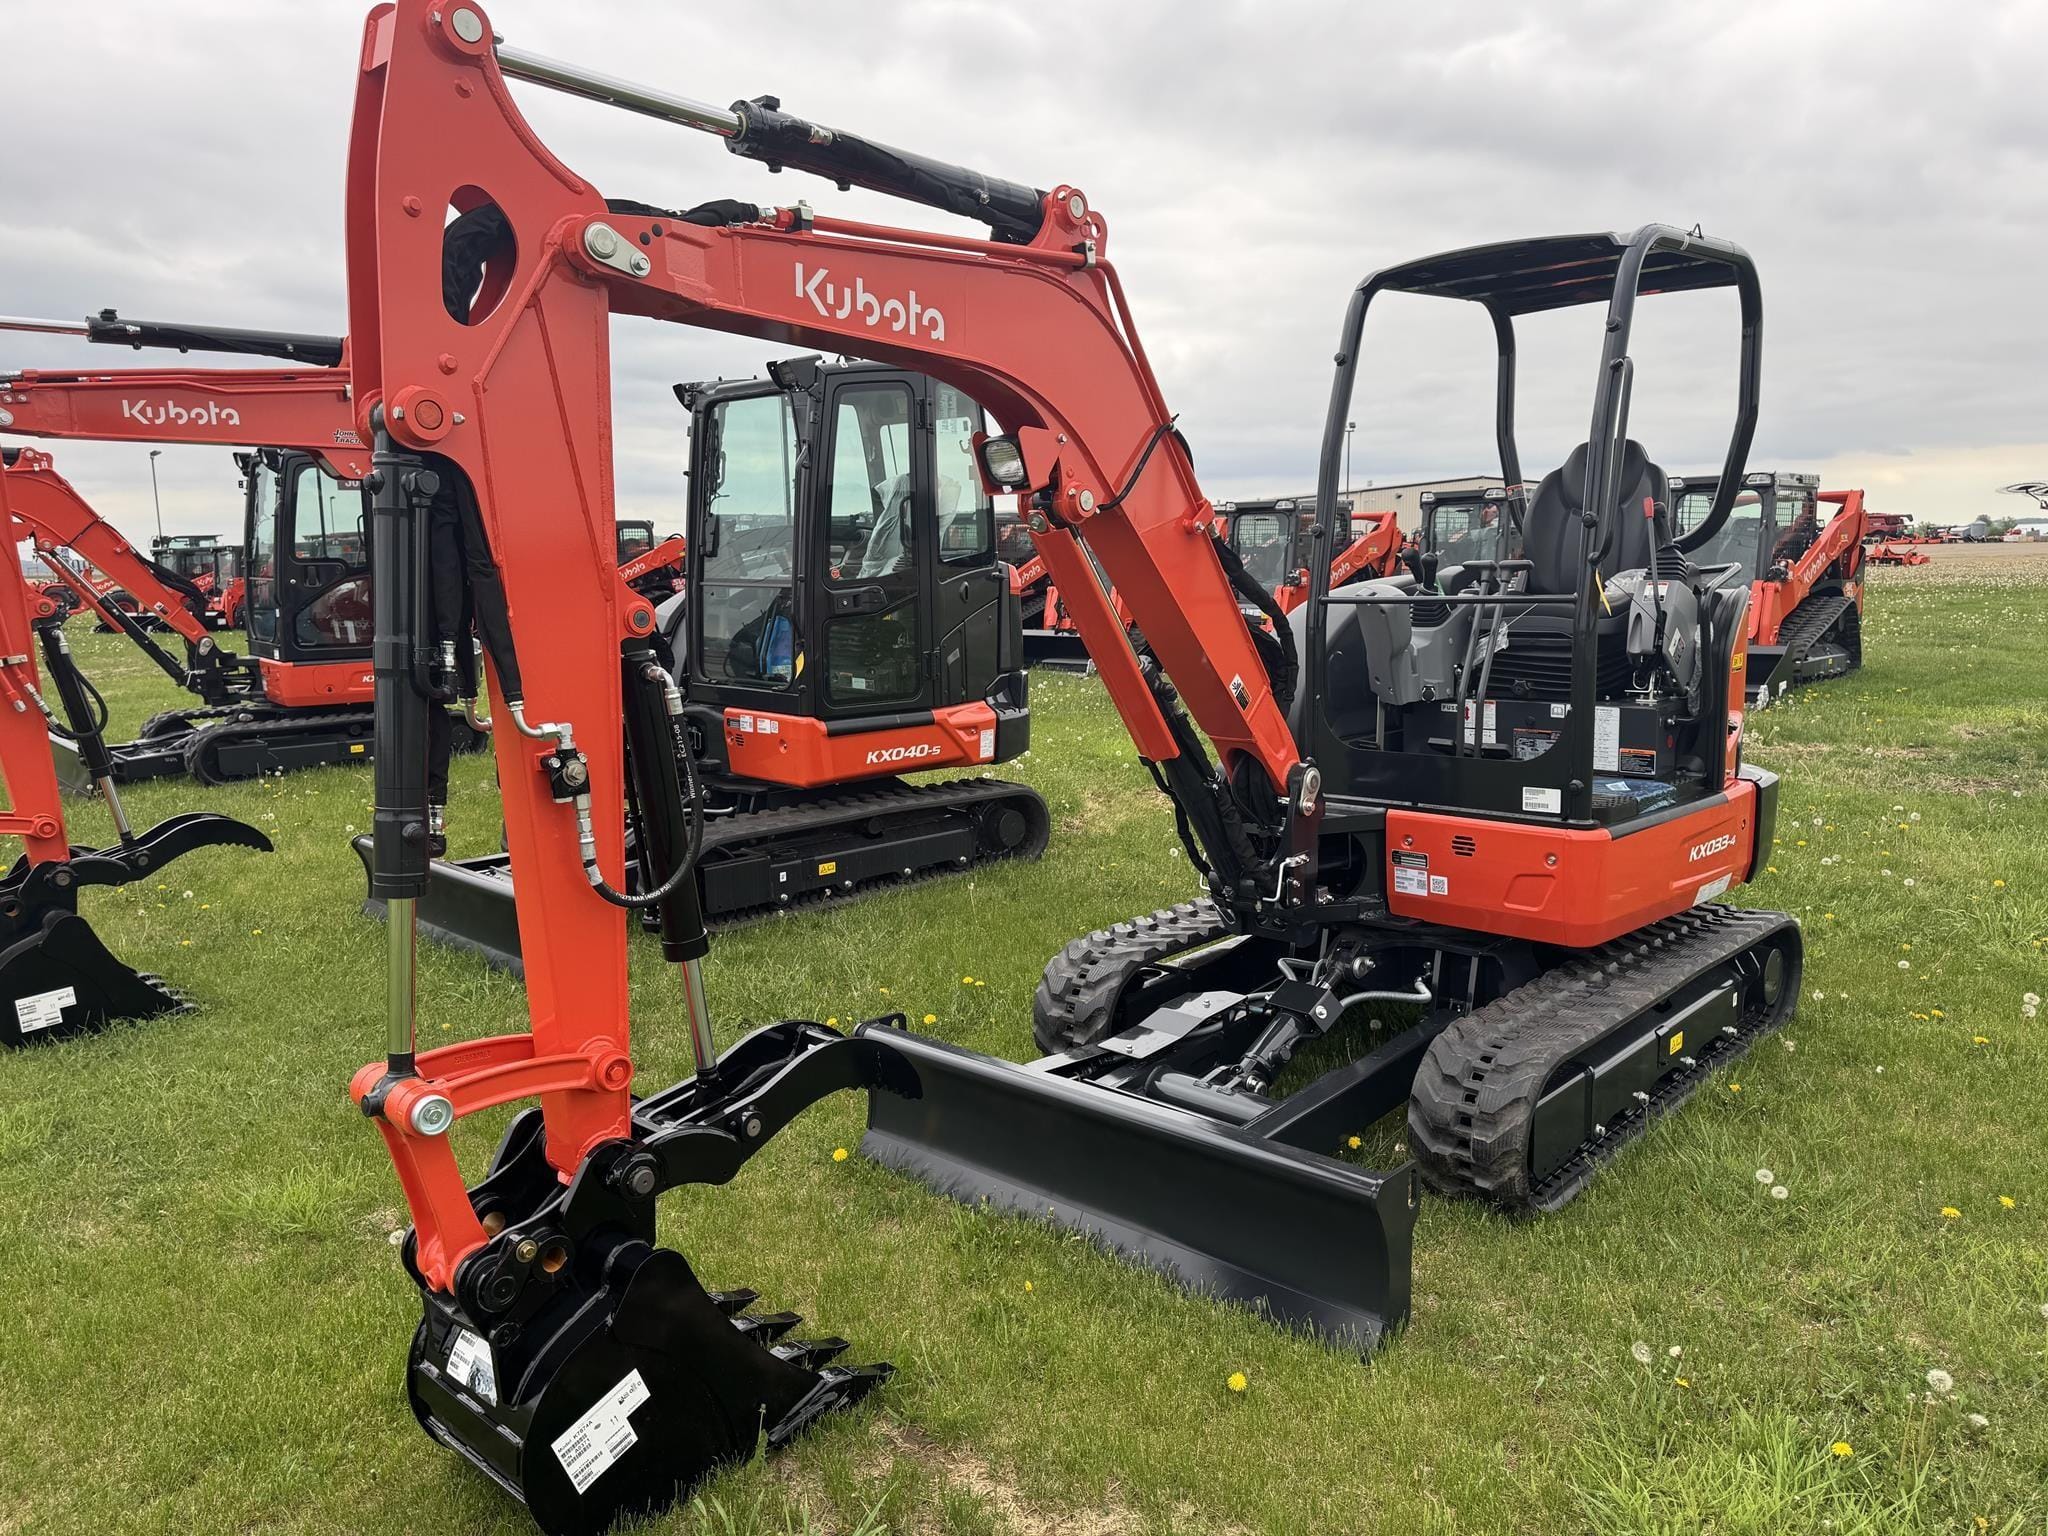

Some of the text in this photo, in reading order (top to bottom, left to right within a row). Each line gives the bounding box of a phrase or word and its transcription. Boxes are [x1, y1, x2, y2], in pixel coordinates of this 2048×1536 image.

[795, 262, 945, 342] Kubota
[122, 399, 240, 425] Kubota
[619, 562, 646, 580] ubota
[1803, 552, 1826, 583] Kubota
[688, 773, 697, 799] Winner
[1689, 834, 1737, 863] KX033-4
